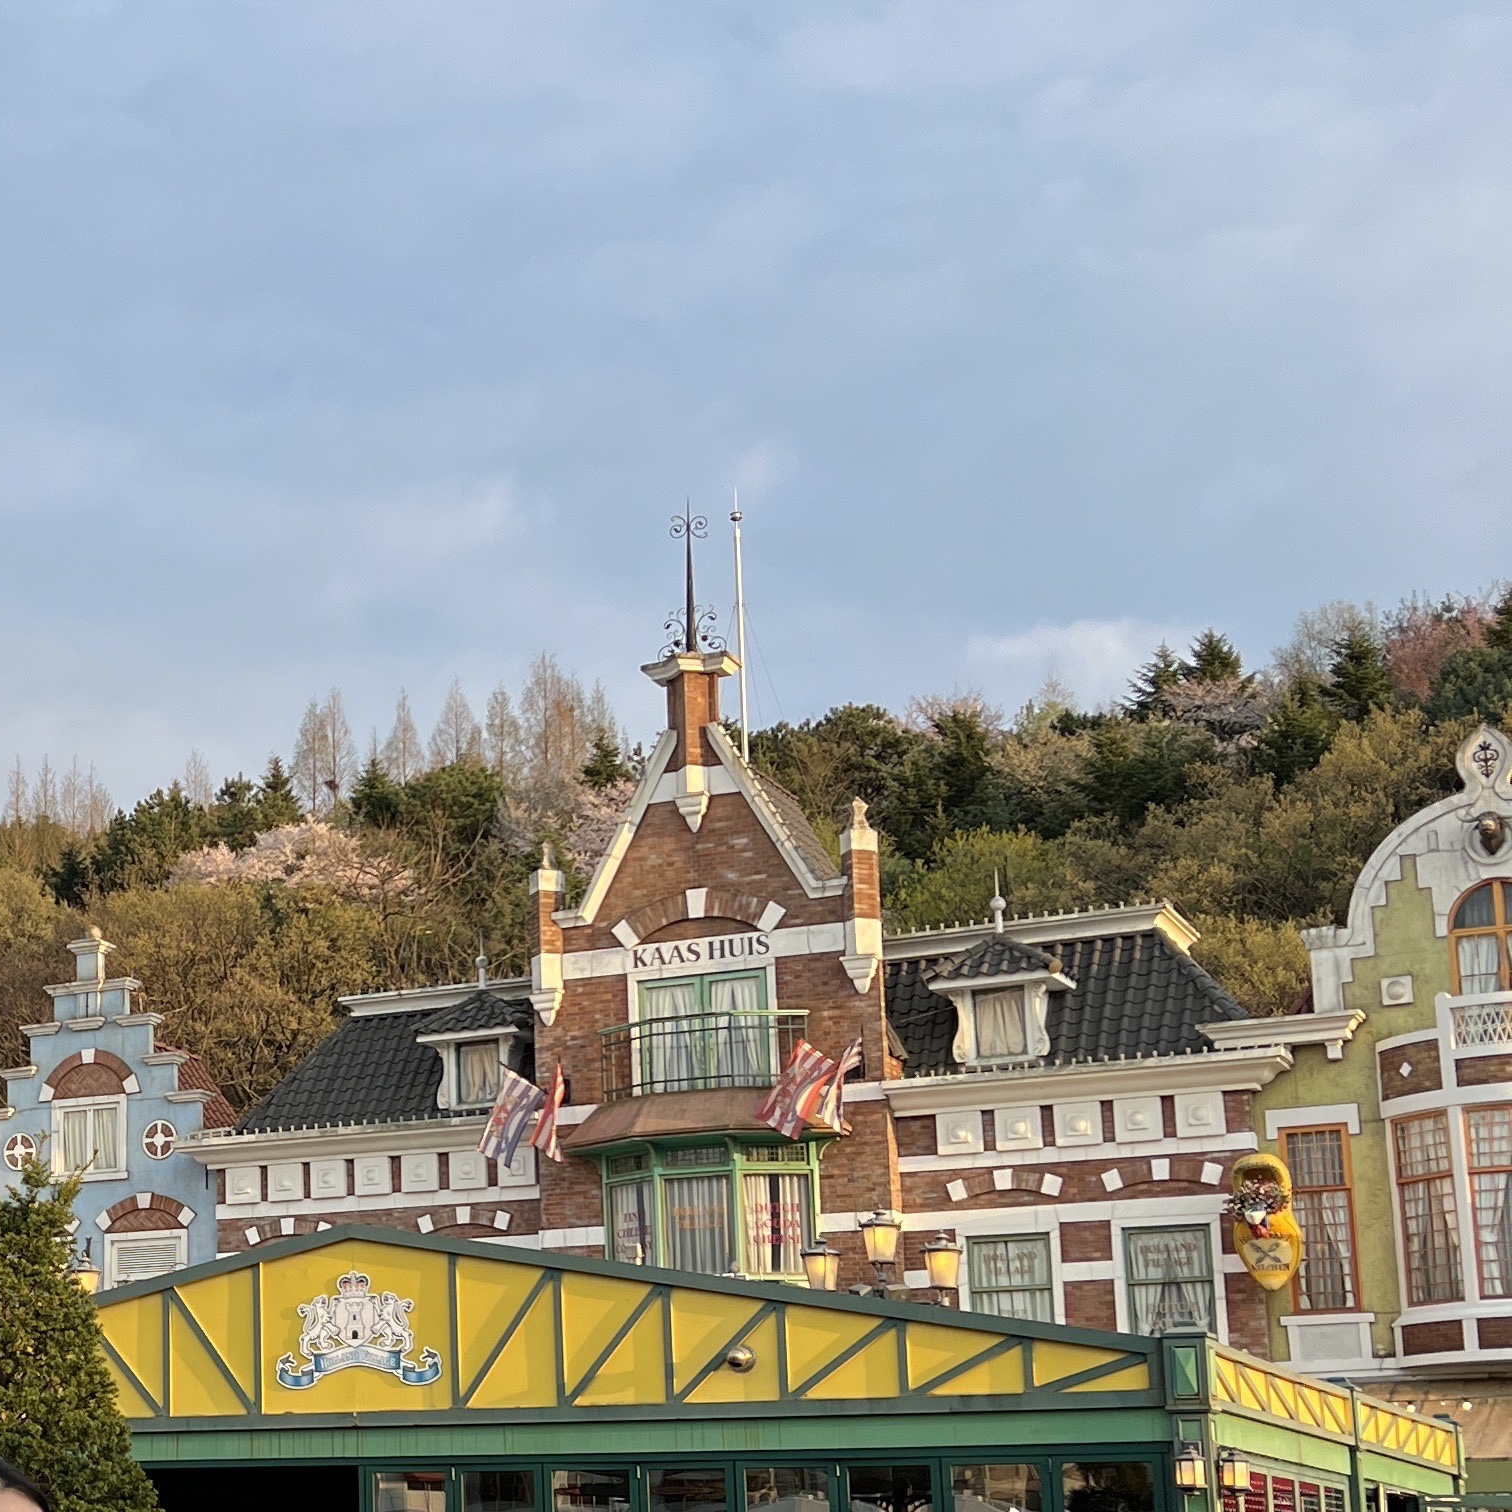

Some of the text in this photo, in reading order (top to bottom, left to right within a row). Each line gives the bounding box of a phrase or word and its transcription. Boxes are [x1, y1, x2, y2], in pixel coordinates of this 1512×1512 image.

[632, 933, 770, 969] KAAS HUIS
[755, 1202, 800, 1213] DUTCH
